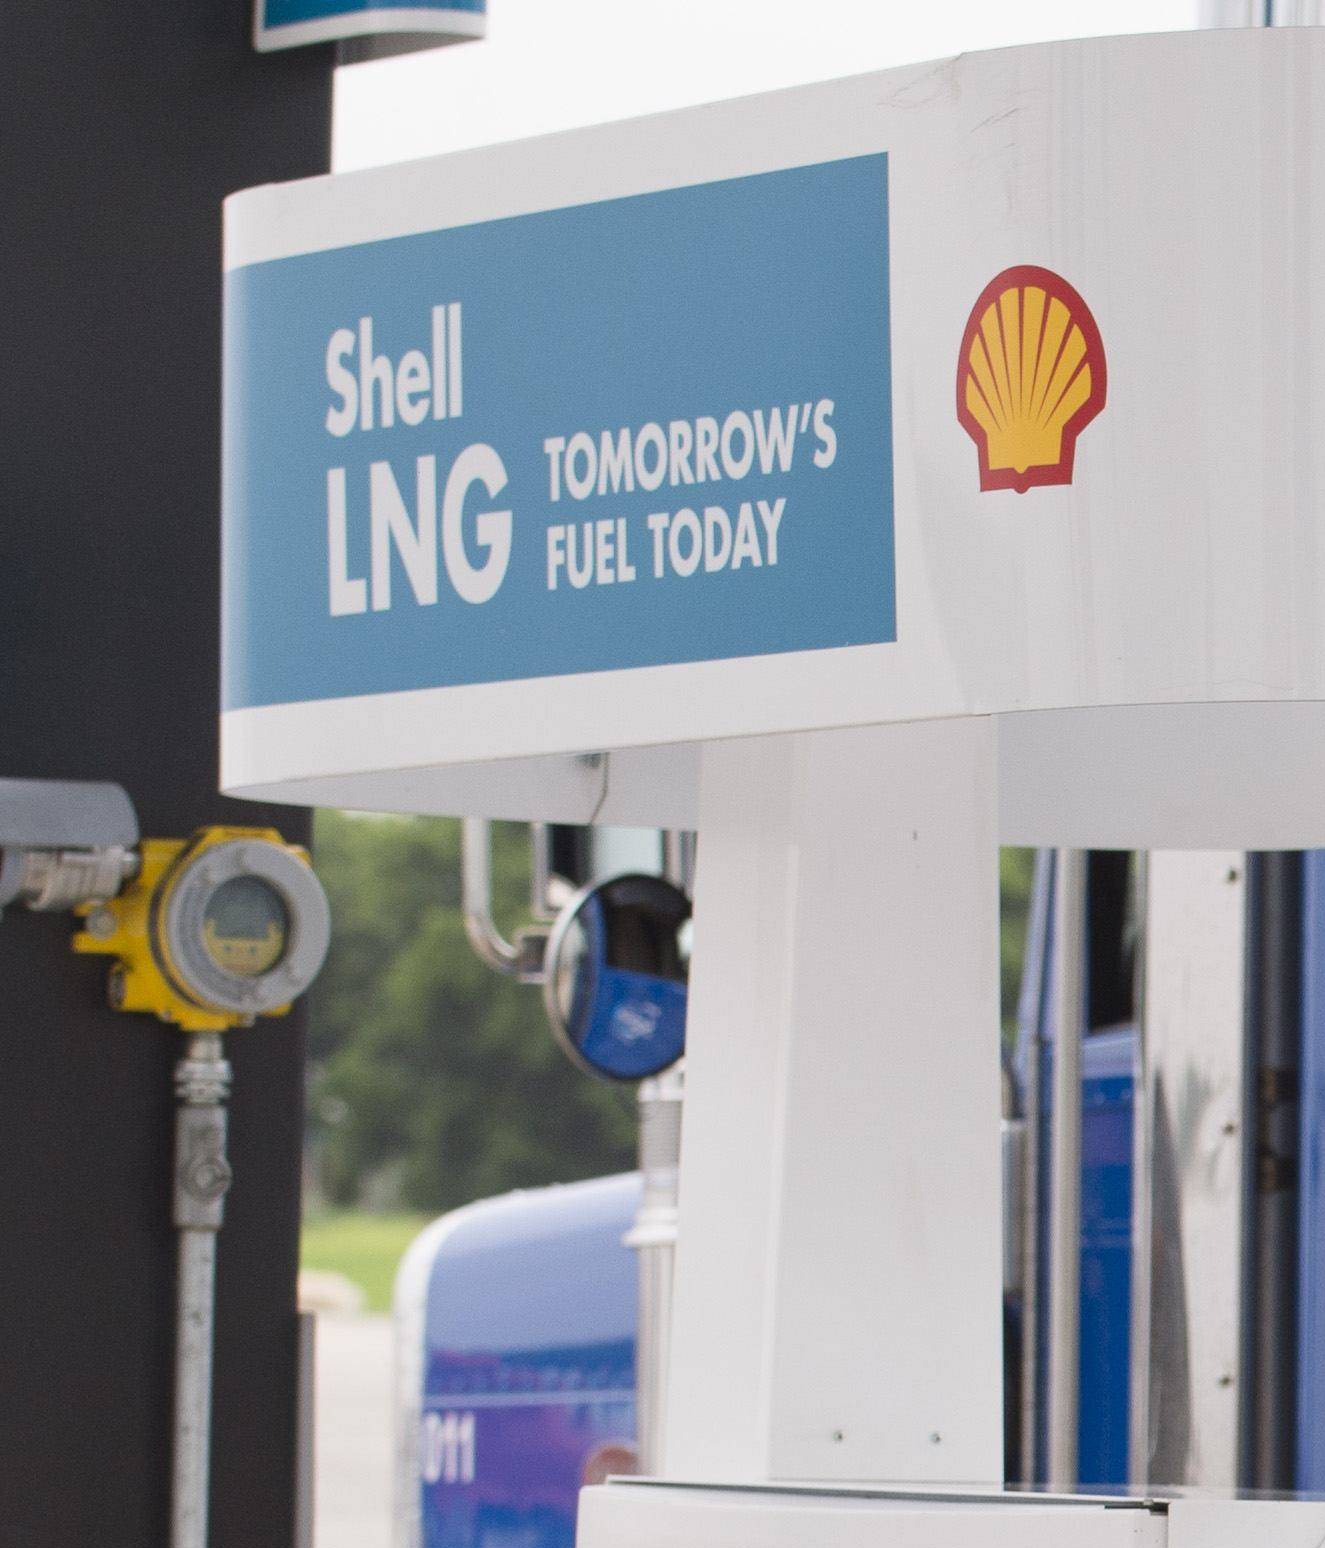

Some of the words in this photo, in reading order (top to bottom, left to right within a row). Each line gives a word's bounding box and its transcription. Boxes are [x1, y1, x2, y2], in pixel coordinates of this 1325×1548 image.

[325, 302, 462, 438] Shell
[544, 399, 837, 502] TOMORROW'S
[327, 443, 513, 617] LNG
[546, 516, 636, 591] FUEL
[648, 497, 788, 580] TODAY
